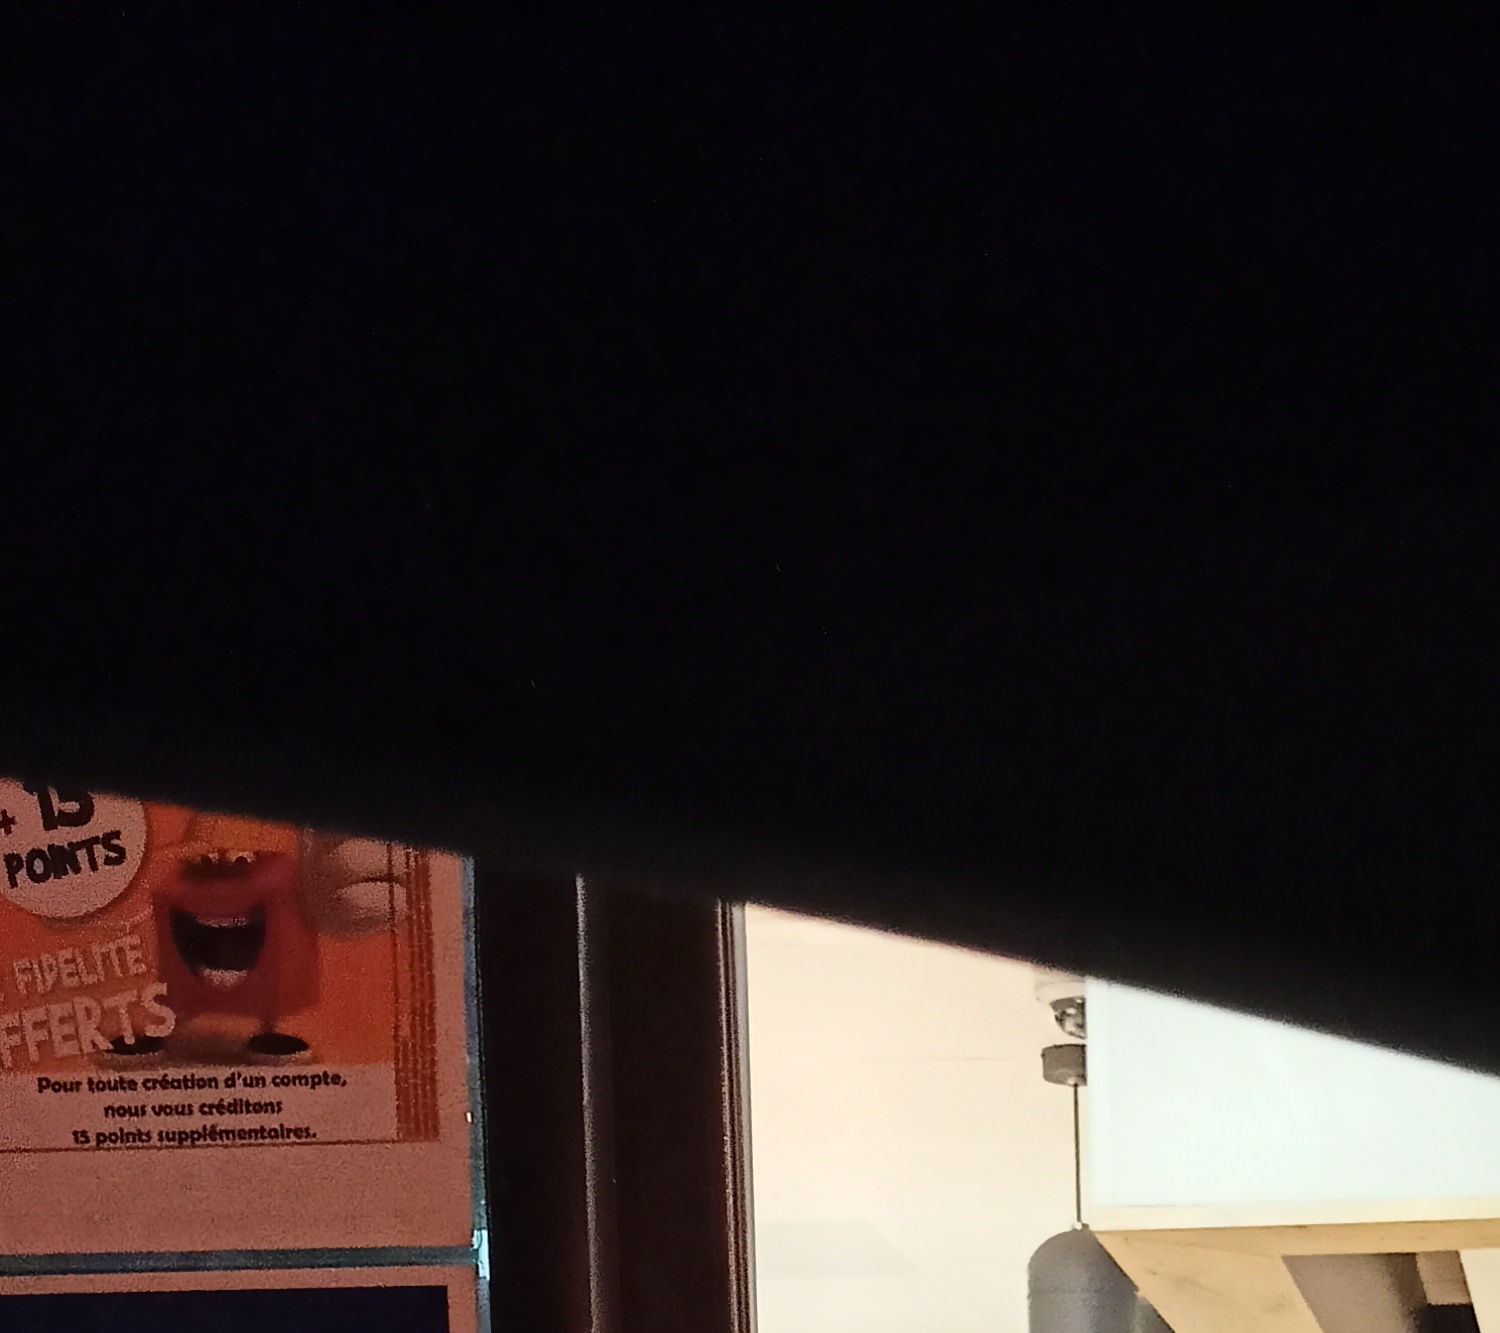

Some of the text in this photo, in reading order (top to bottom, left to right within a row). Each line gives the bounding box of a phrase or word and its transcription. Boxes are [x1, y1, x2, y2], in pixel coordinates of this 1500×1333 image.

[4, 830, 127, 888] POINTS
[37, 1070, 347, 1094] Pour toute création d'un compte,
[104, 1098, 283, 1118] nous vous créditons
[72, 1123, 317, 1147] 15 points supplémentaires.
